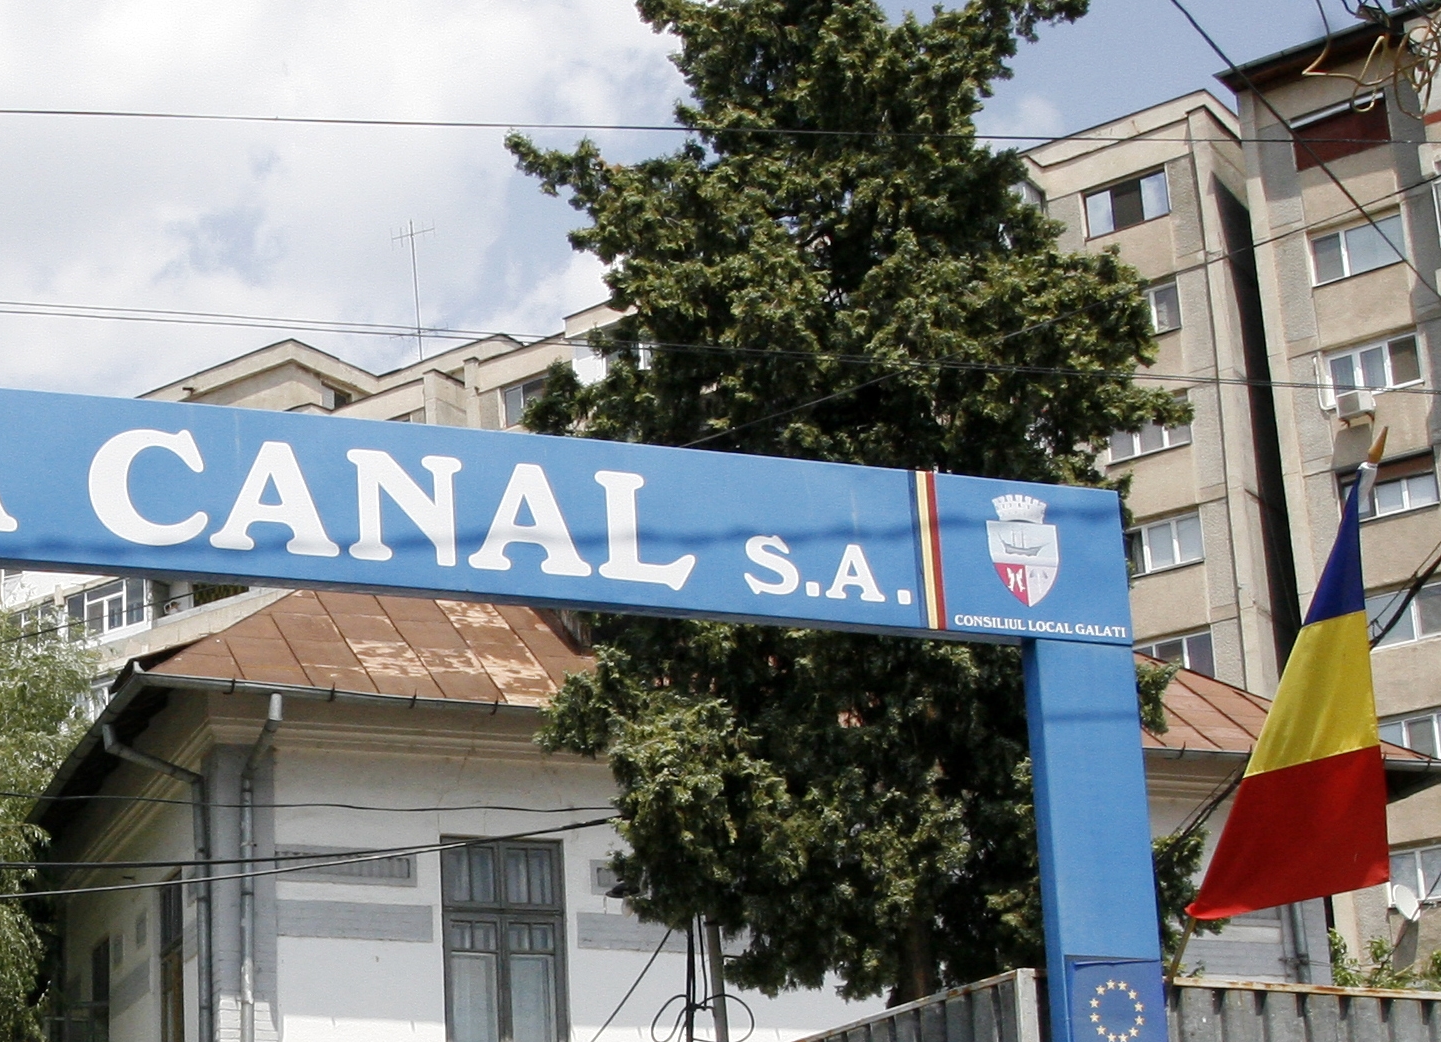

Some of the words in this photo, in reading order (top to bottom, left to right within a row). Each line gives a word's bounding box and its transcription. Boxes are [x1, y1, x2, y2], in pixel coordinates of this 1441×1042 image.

[88, 429, 697, 592] CANAL
[743, 535, 912, 606] S.A.
[954, 614, 1026, 631] CONSILIUL
[1028, 619, 1072, 634] LOCAL
[1075, 623, 1126, 638] GALATI
